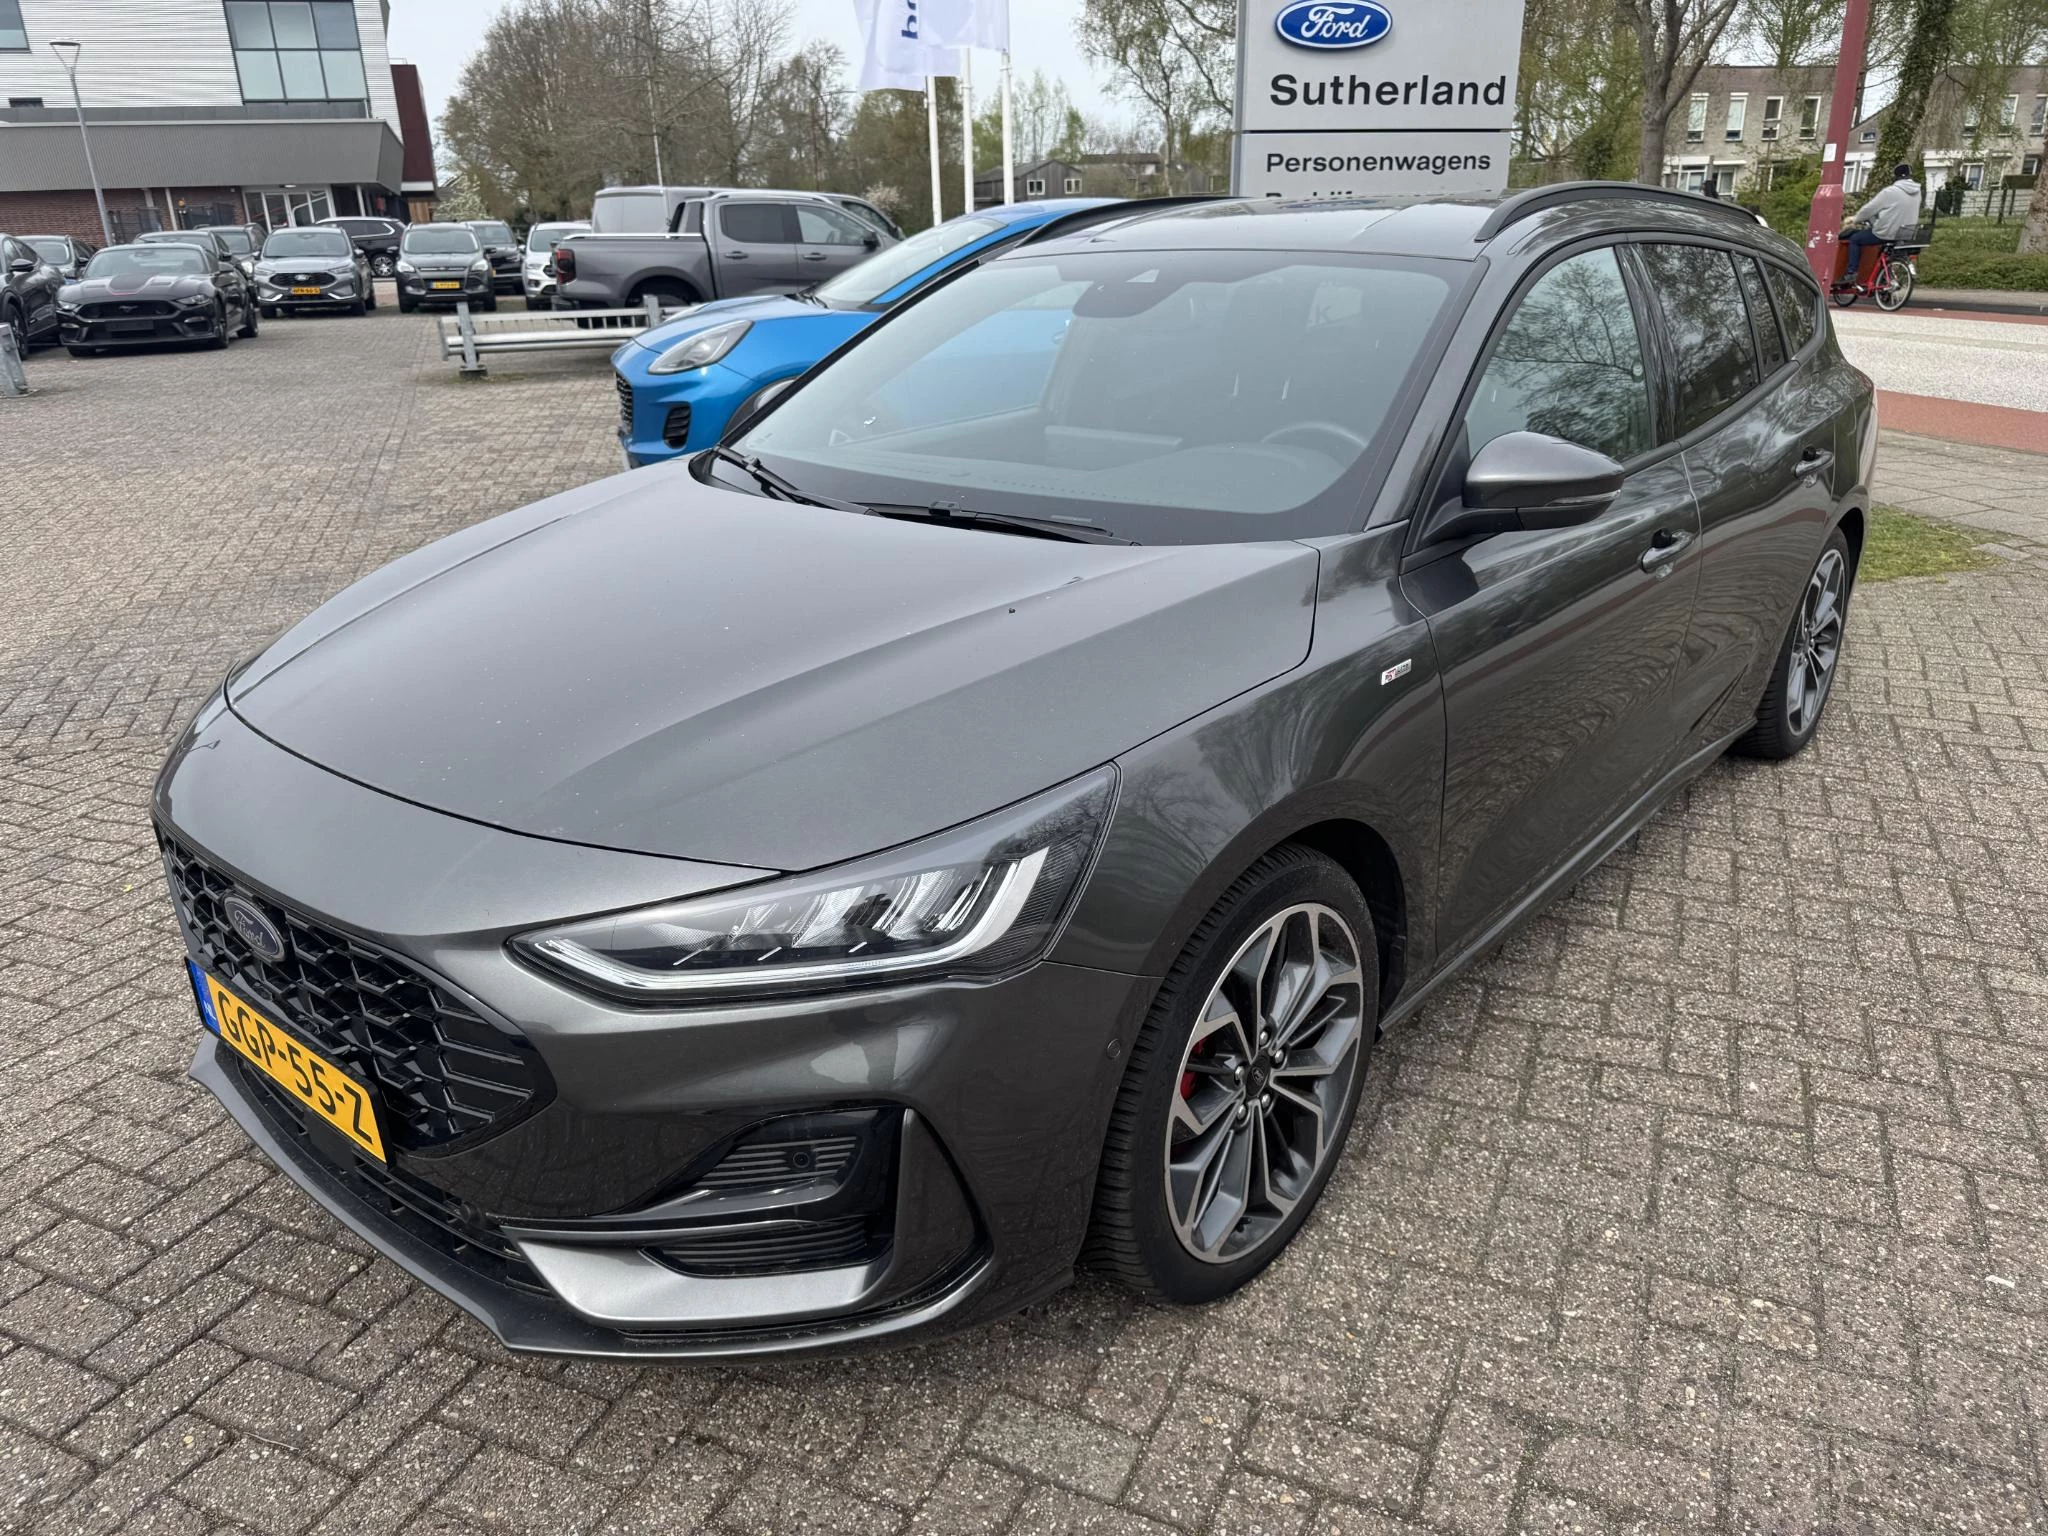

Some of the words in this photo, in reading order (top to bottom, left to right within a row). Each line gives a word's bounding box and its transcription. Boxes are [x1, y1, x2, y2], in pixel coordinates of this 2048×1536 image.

[1300, 5, 1371, 39] Ford
[1270, 74, 1506, 106] Sutherland
[1266, 153, 1491, 175] Personenwagens
[234, 909, 265, 949] Ford
[217, 990, 374, 1146] GGP-55-Z
